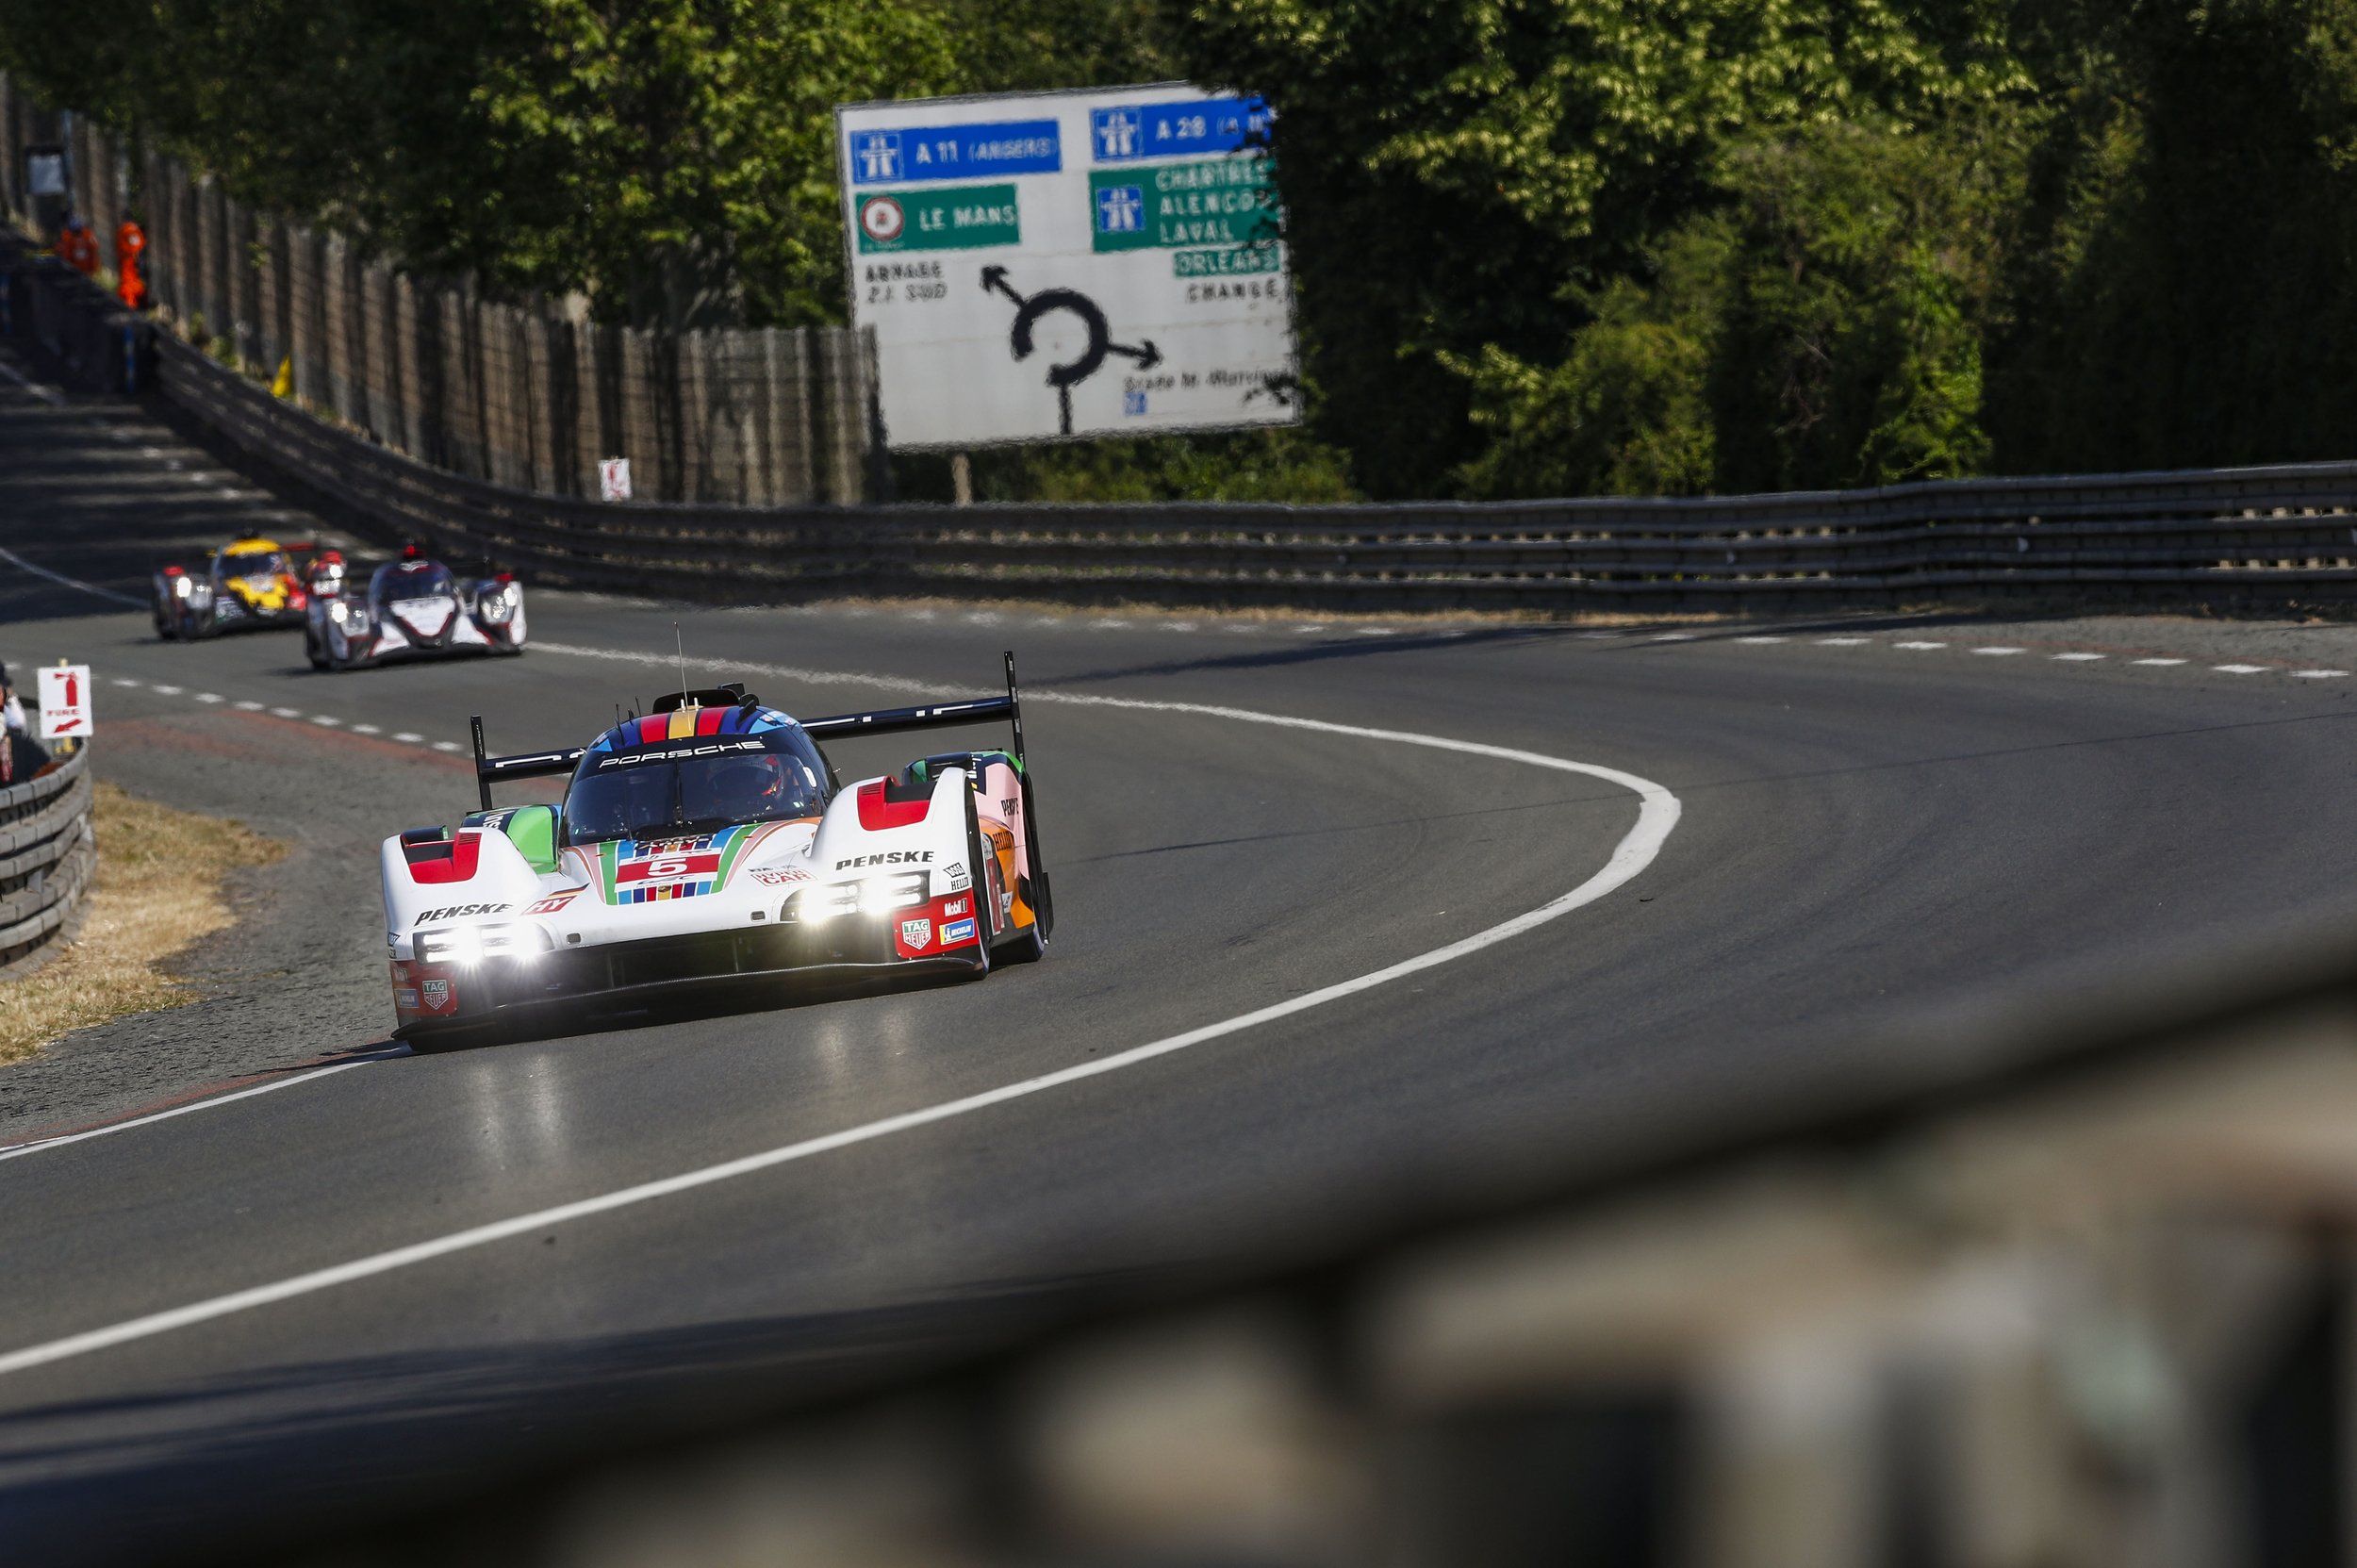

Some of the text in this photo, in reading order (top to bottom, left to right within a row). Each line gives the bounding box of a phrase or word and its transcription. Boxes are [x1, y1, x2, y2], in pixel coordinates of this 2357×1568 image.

[1156, 118, 1172, 140] A
[1177, 114, 1207, 140] 28
[915, 142, 931, 164] A
[935, 140, 958, 163] 11
[919, 204, 1016, 232] LE MANS
[1160, 218, 1235, 243] LAVAL
[599, 740, 766, 769] PORSCHE
[647, 858, 688, 877] 5
[835, 850, 935, 871] PENSKE
[762, 873, 812, 884] CAR
[413, 903, 514, 927] PENSKE
[944, 900, 962, 917] Mobil
[906, 920, 929, 933] TAG
[904, 931, 931, 947] HEUER
[423, 982, 445, 992] TAG
[424, 993, 447, 1008] HEUER
